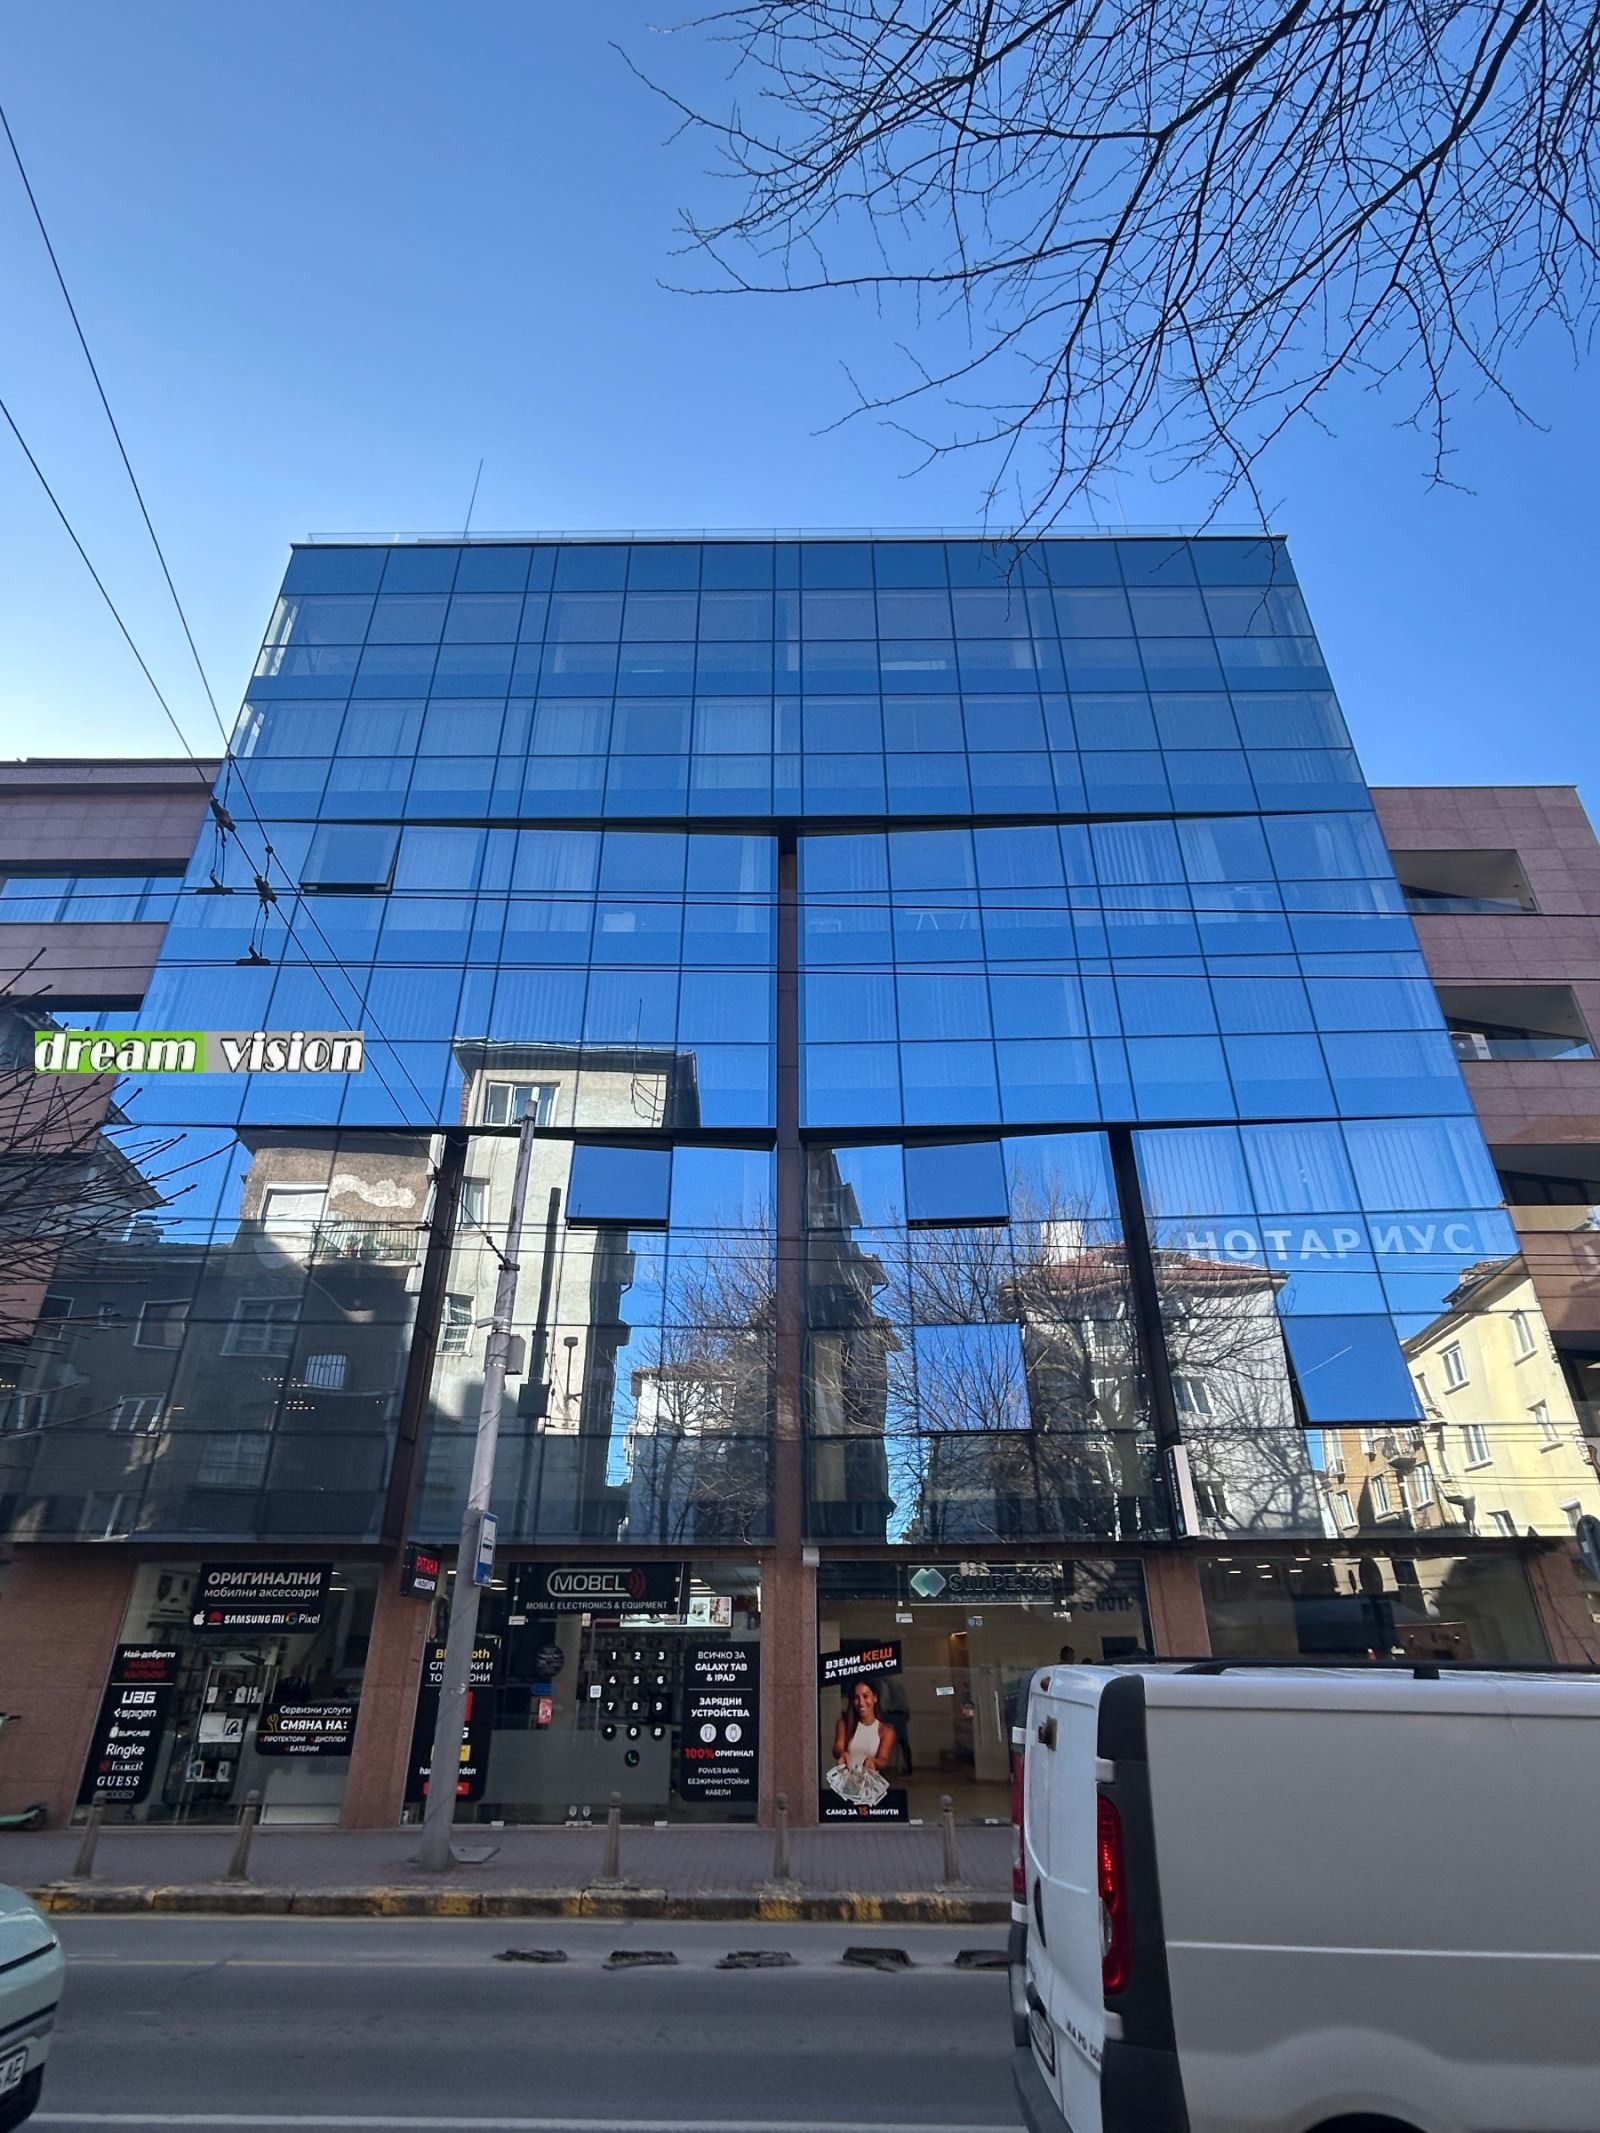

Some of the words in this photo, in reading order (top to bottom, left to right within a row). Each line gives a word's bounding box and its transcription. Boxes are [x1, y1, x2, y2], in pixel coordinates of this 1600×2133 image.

[1186, 1222, 1478, 1260] НОТАРИУС
[208, 1572, 321, 1585] ОРИГИНАЛНИ
[204, 1587, 257, 1598] мобилни
[259, 1588, 319, 1599] аксесоари
[526, 1601, 555, 1610] MOBILE
[557, 1601, 613, 1610] ELECTRONICS
[614, 1601, 620, 1610] &
[622, 1601, 668, 1610] EQUIPMENT
[224, 1614, 271, 1624] SAMSUNG
[298, 1613, 320, 1624] Pixel
[435, 1648, 490, 1659] Bloth
[611, 1651, 617, 1660] 1
[634, 1651, 641, 1660] 2
[658, 1651, 665, 1660] 3
[698, 1651, 733, 1659] ВСИЧКО
[734, 1651, 745, 1659] ЗА
[825, 1655, 861, 1669] ВЗЕМИ
[863, 1647, 893, 1662] КЕШ
[695, 1663, 729, 1671] GALAXY
[731, 1663, 748, 1671] TAB
[825, 1670, 836, 1679] ЗА
[838, 1662, 883, 1676] ТЕЛЕФОНА
[885, 1659, 897, 1667] СИ
[609, 1676, 616, 1684] 4
[633, 1676, 640, 1684] 5
[657, 1676, 664, 1684] 6
[121, 1691, 156, 1704] UAG
[699, 1697, 742, 1706] ЗАРЯДНИ
[280, 1705, 321, 1715] Сервизни
[323, 1706, 352, 1715] услуги
[607, 1702, 614, 1711] 7
[632, 1702, 639, 1711] 8
[655, 1702, 662, 1711] 9
[691, 1707, 750, 1717] УСТРОЙСТВА
[280, 1720, 322, 1730] СМЯНА
[325, 1720, 348, 1730] НА:
[630, 1728, 637, 1736] 0
[105, 1743, 145, 1759] Ringke
[685, 1748, 714, 1759] 100%
[96, 1776, 140, 1786] GUESS
[859, 1807, 869, 1816] 15
